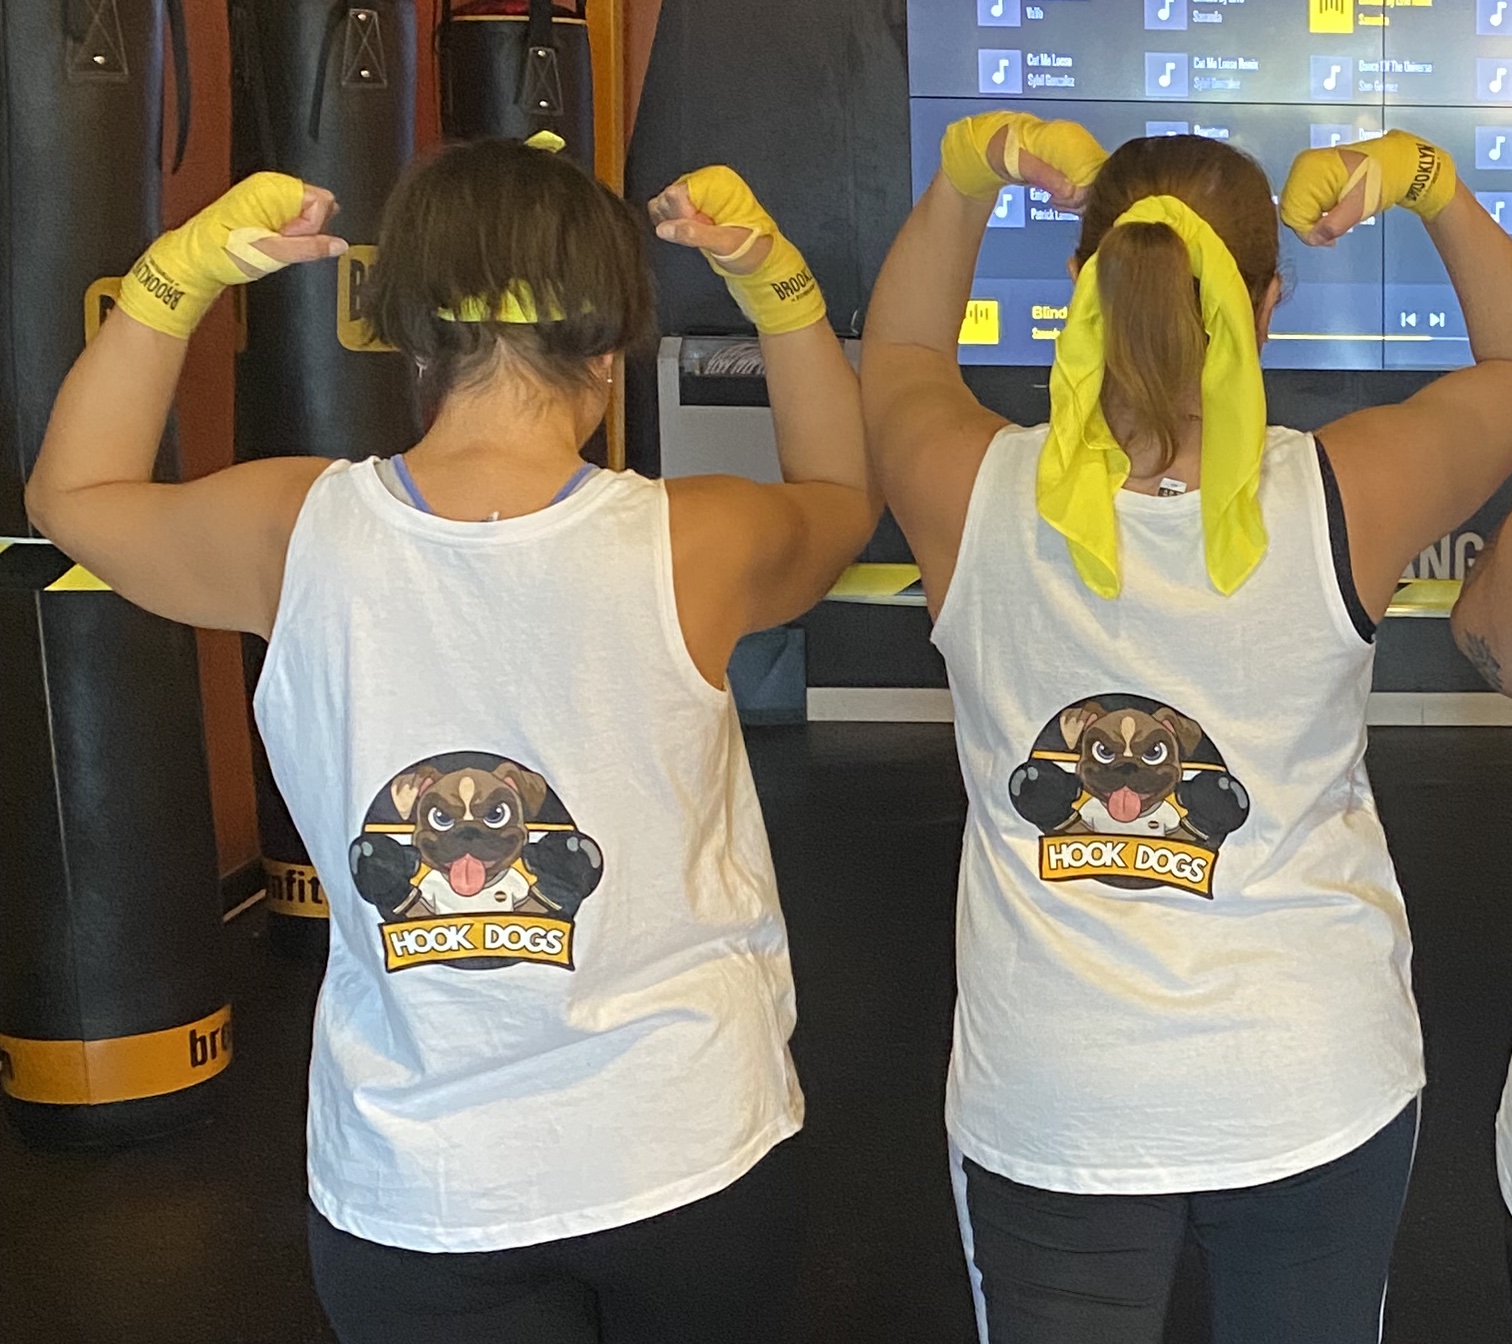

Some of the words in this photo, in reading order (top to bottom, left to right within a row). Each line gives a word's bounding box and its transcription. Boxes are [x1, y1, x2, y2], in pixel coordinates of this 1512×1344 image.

[1040, 53, 1052, 66] Me
[1031, 305, 1068, 320] Blind
[1048, 840, 1128, 870] HOOK
[1134, 843, 1208, 883] DOGS
[389, 922, 477, 957] HOOK
[482, 922, 566, 956] DOGS
